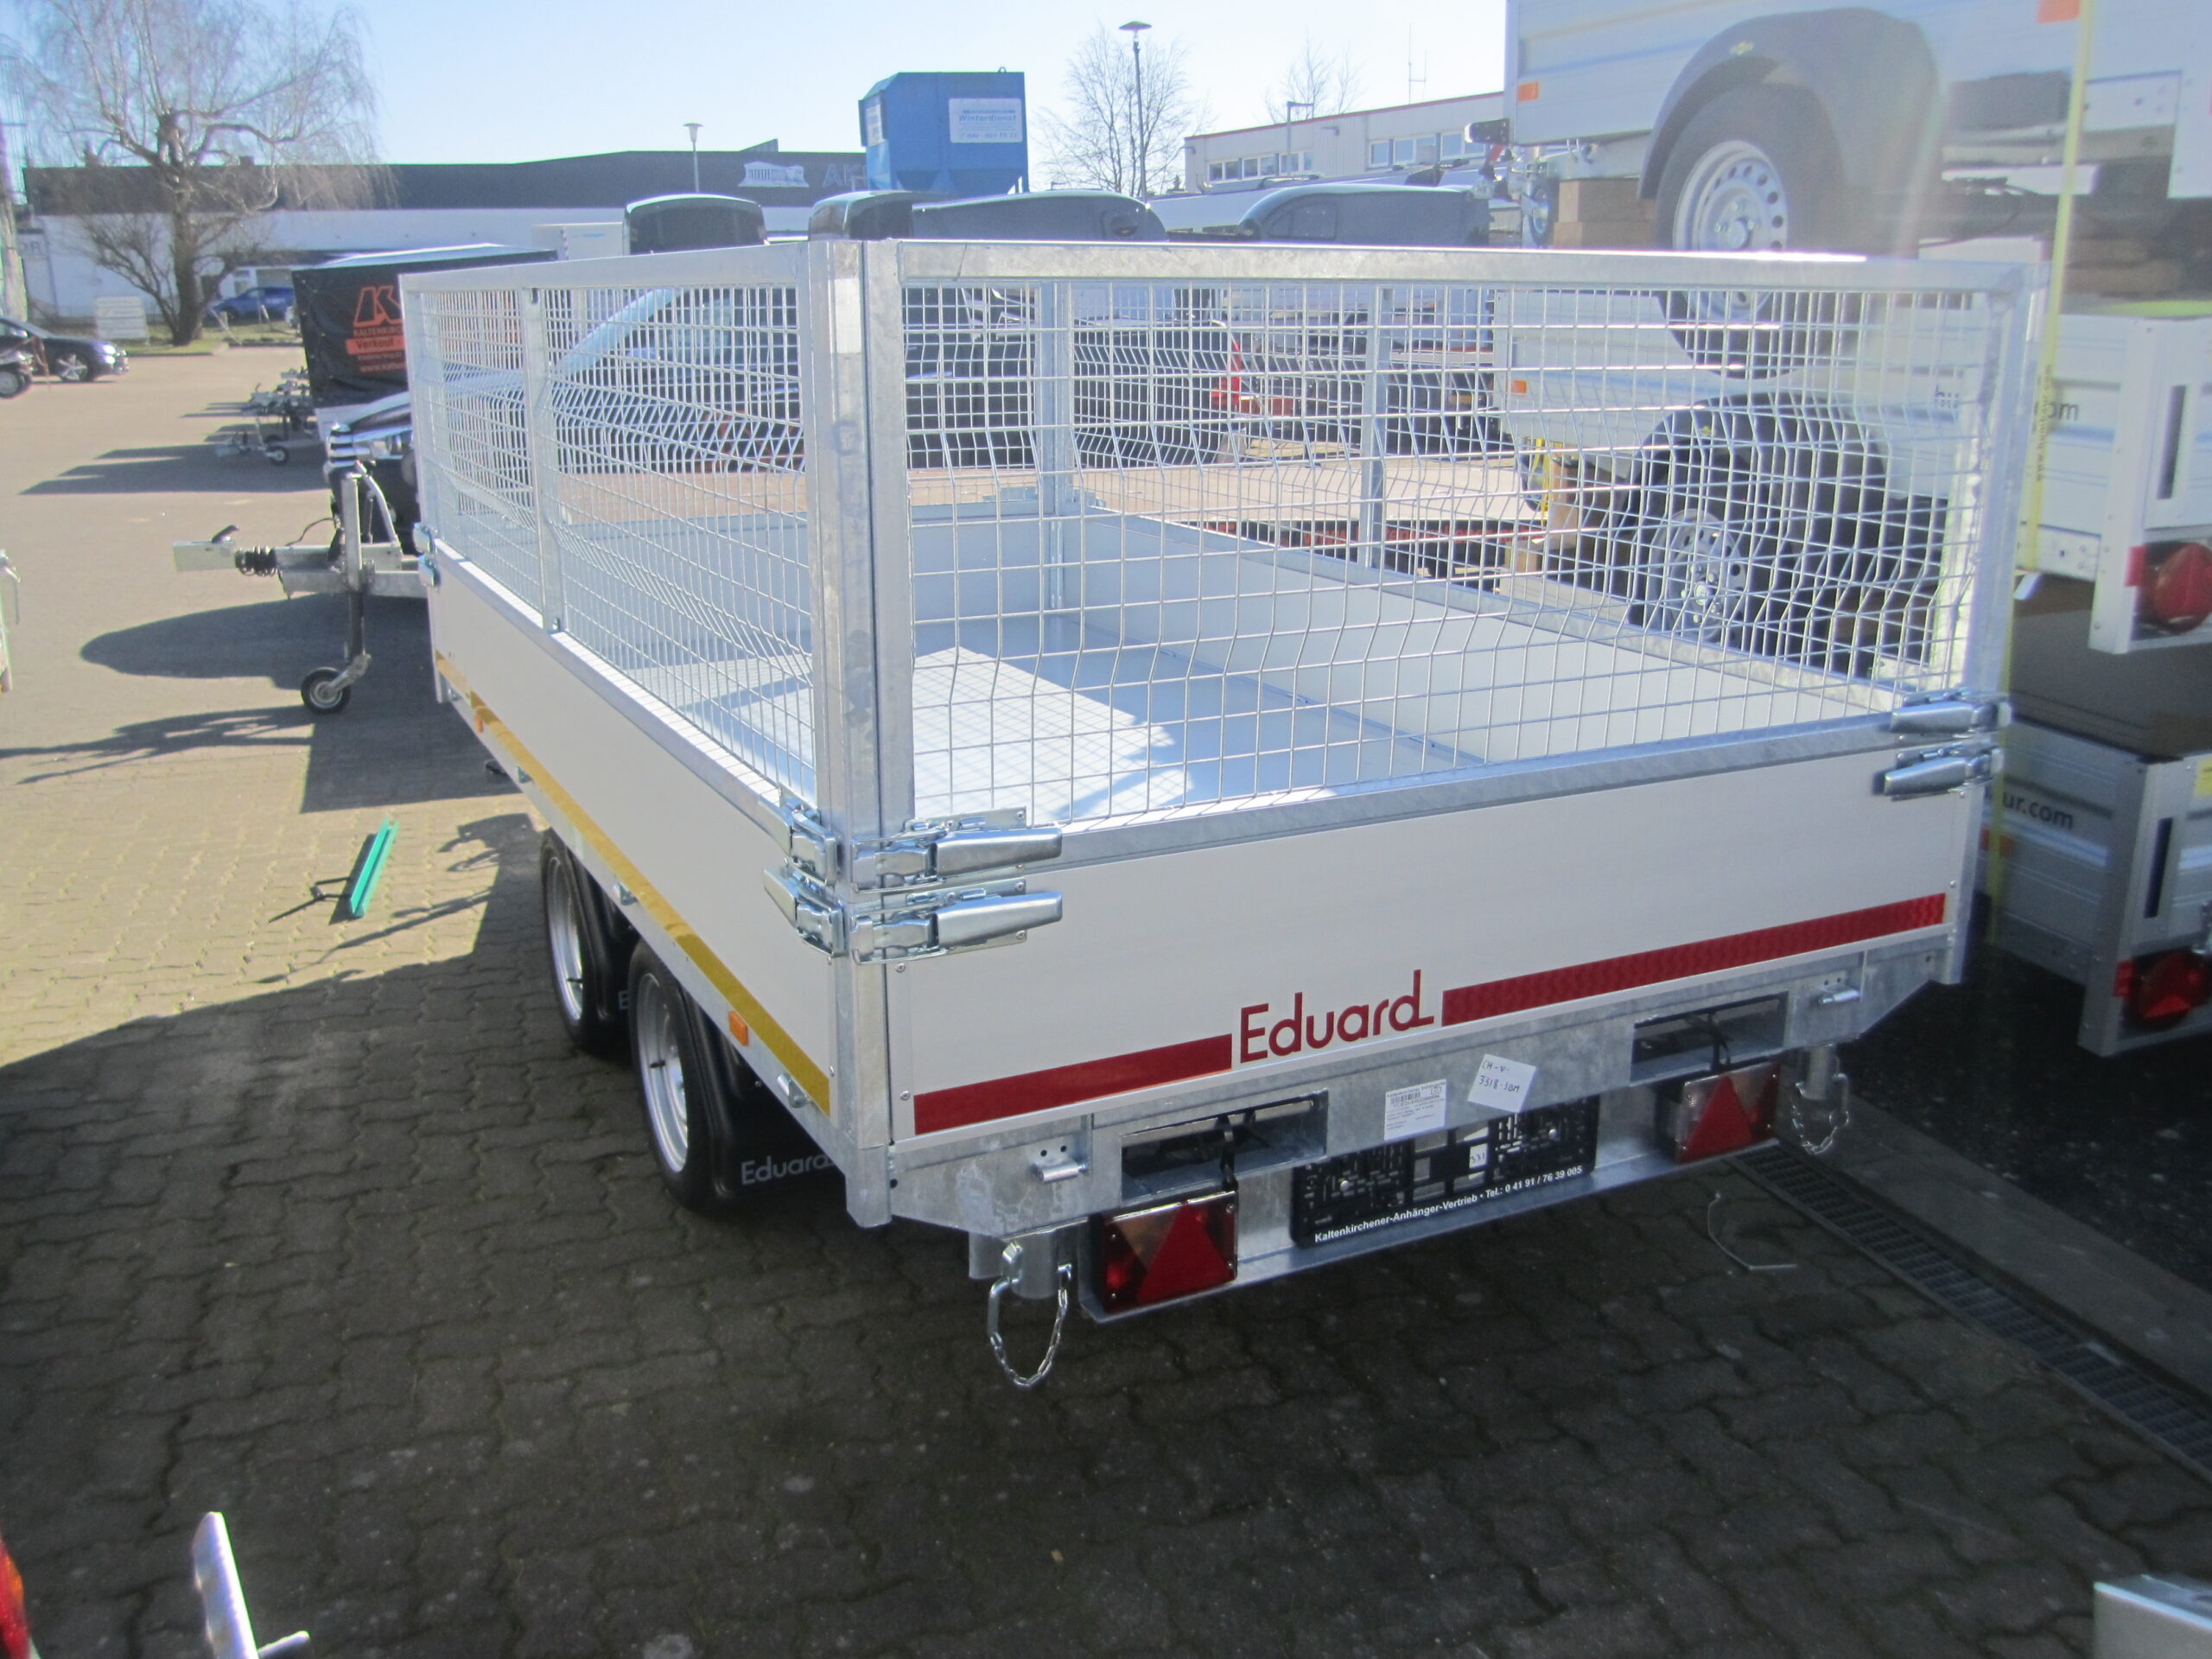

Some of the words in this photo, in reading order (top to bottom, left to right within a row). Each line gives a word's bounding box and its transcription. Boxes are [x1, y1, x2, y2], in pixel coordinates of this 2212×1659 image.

[1240, 969, 1434, 1064] Eduard
[1314, 1193, 1478, 1243] Kaltenkirchener-Anhänger-Vertrieb
[1485, 1187, 1504, 1199] Tel.:
[1504, 1184, 1510, 1192] 0
[1512, 1180, 1522, 1190] 41
[1524, 1178, 1535, 1188] 91
[1542, 1173, 1553, 1183] 76
[1554, 1171, 1565, 1180] 39
[1567, 1166, 1583, 1177] 005
